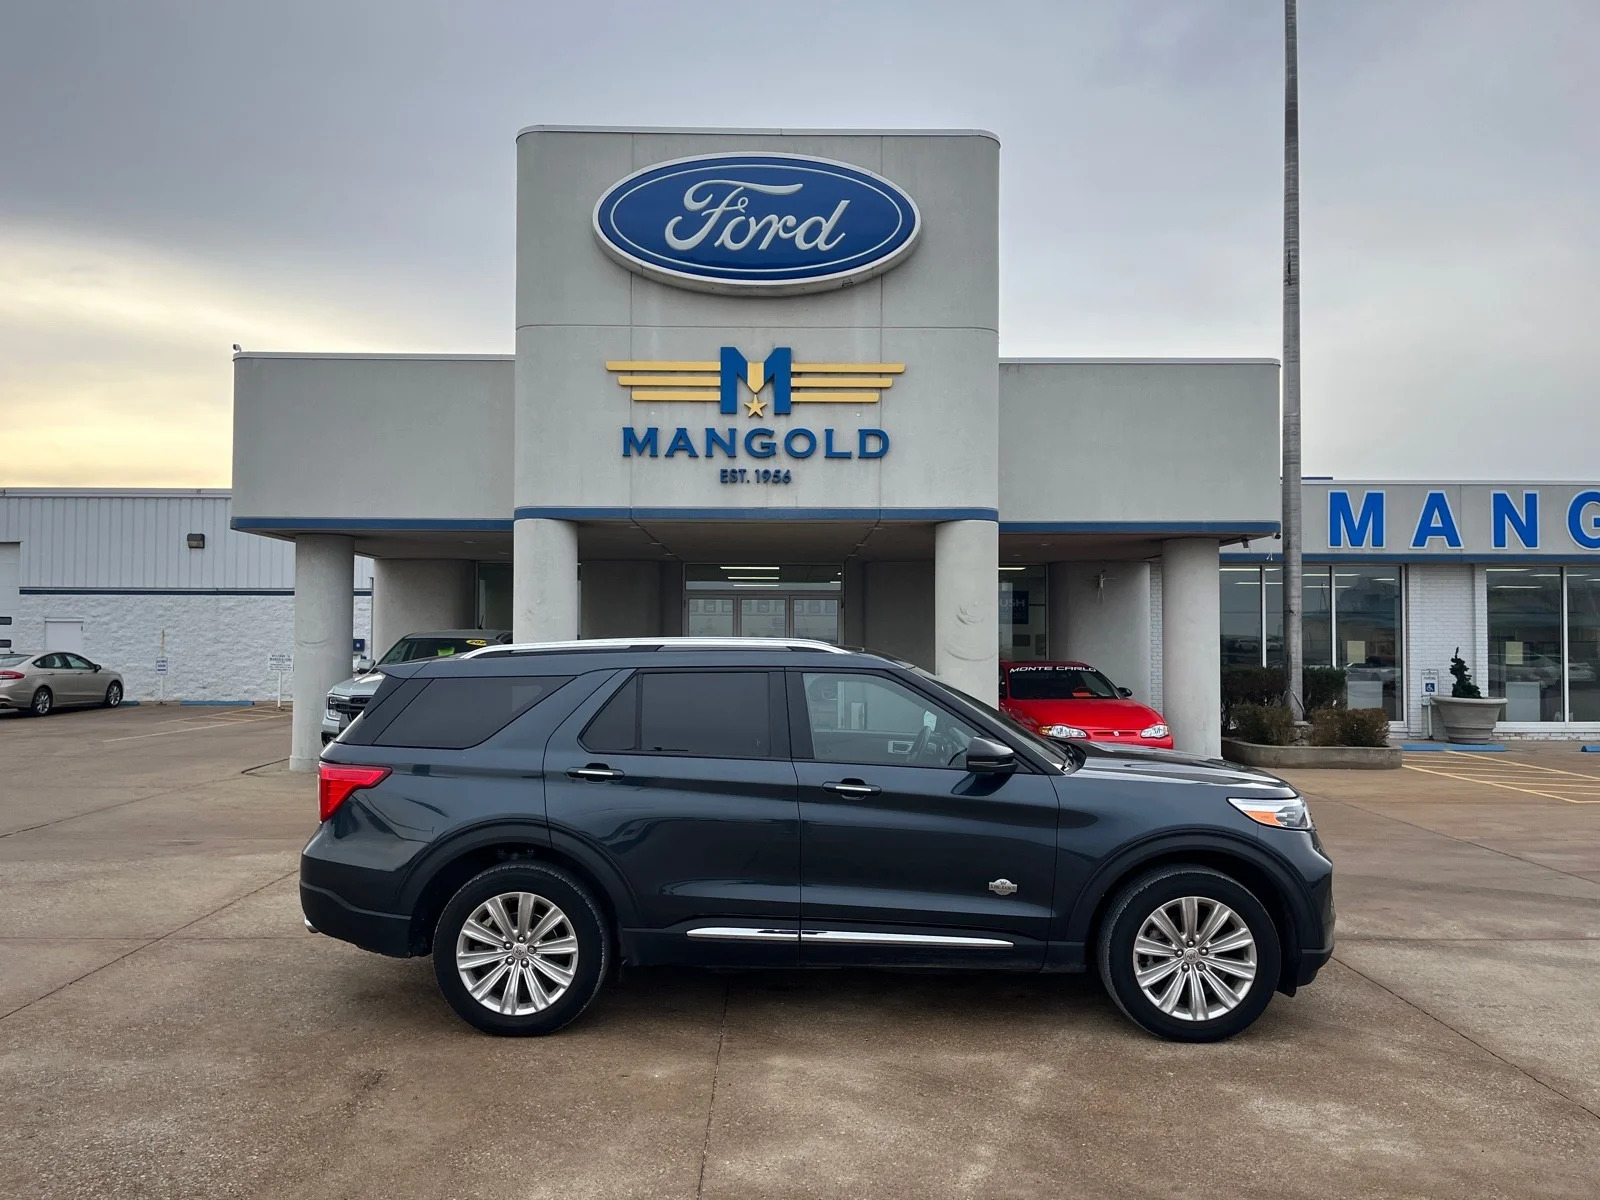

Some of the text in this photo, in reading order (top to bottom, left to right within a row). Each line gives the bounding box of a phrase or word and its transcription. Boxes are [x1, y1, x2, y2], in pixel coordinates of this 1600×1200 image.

[664, 179, 851, 251] Ford
[622, 427, 890, 459] MANGOLD
[720, 469, 792, 484] EST. 1956
[1328, 489, 1600, 550] MANG
